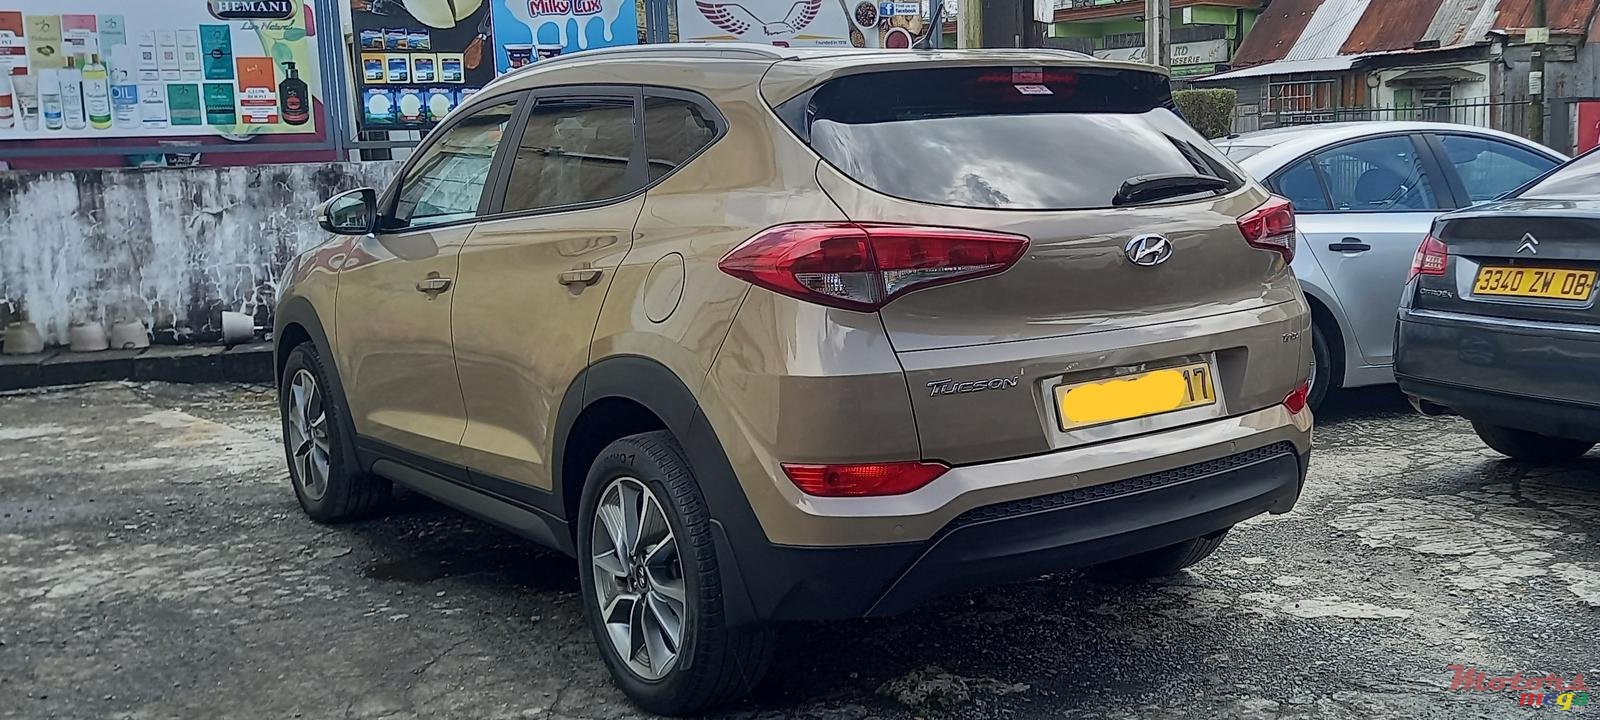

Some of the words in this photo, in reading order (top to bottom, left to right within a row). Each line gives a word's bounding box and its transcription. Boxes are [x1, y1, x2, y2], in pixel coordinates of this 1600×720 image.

[218, 0, 288, 12] HEMANI
[529, 0, 569, 16] Milky
[573, 0, 601, 14] Lux
[112, 87, 132, 99] OIL
[1479, 269, 1524, 292] 3340
[1529, 271, 1555, 294] ZW
[1561, 272, 1589, 295] 08
[1183, 367, 1208, 402] 17
